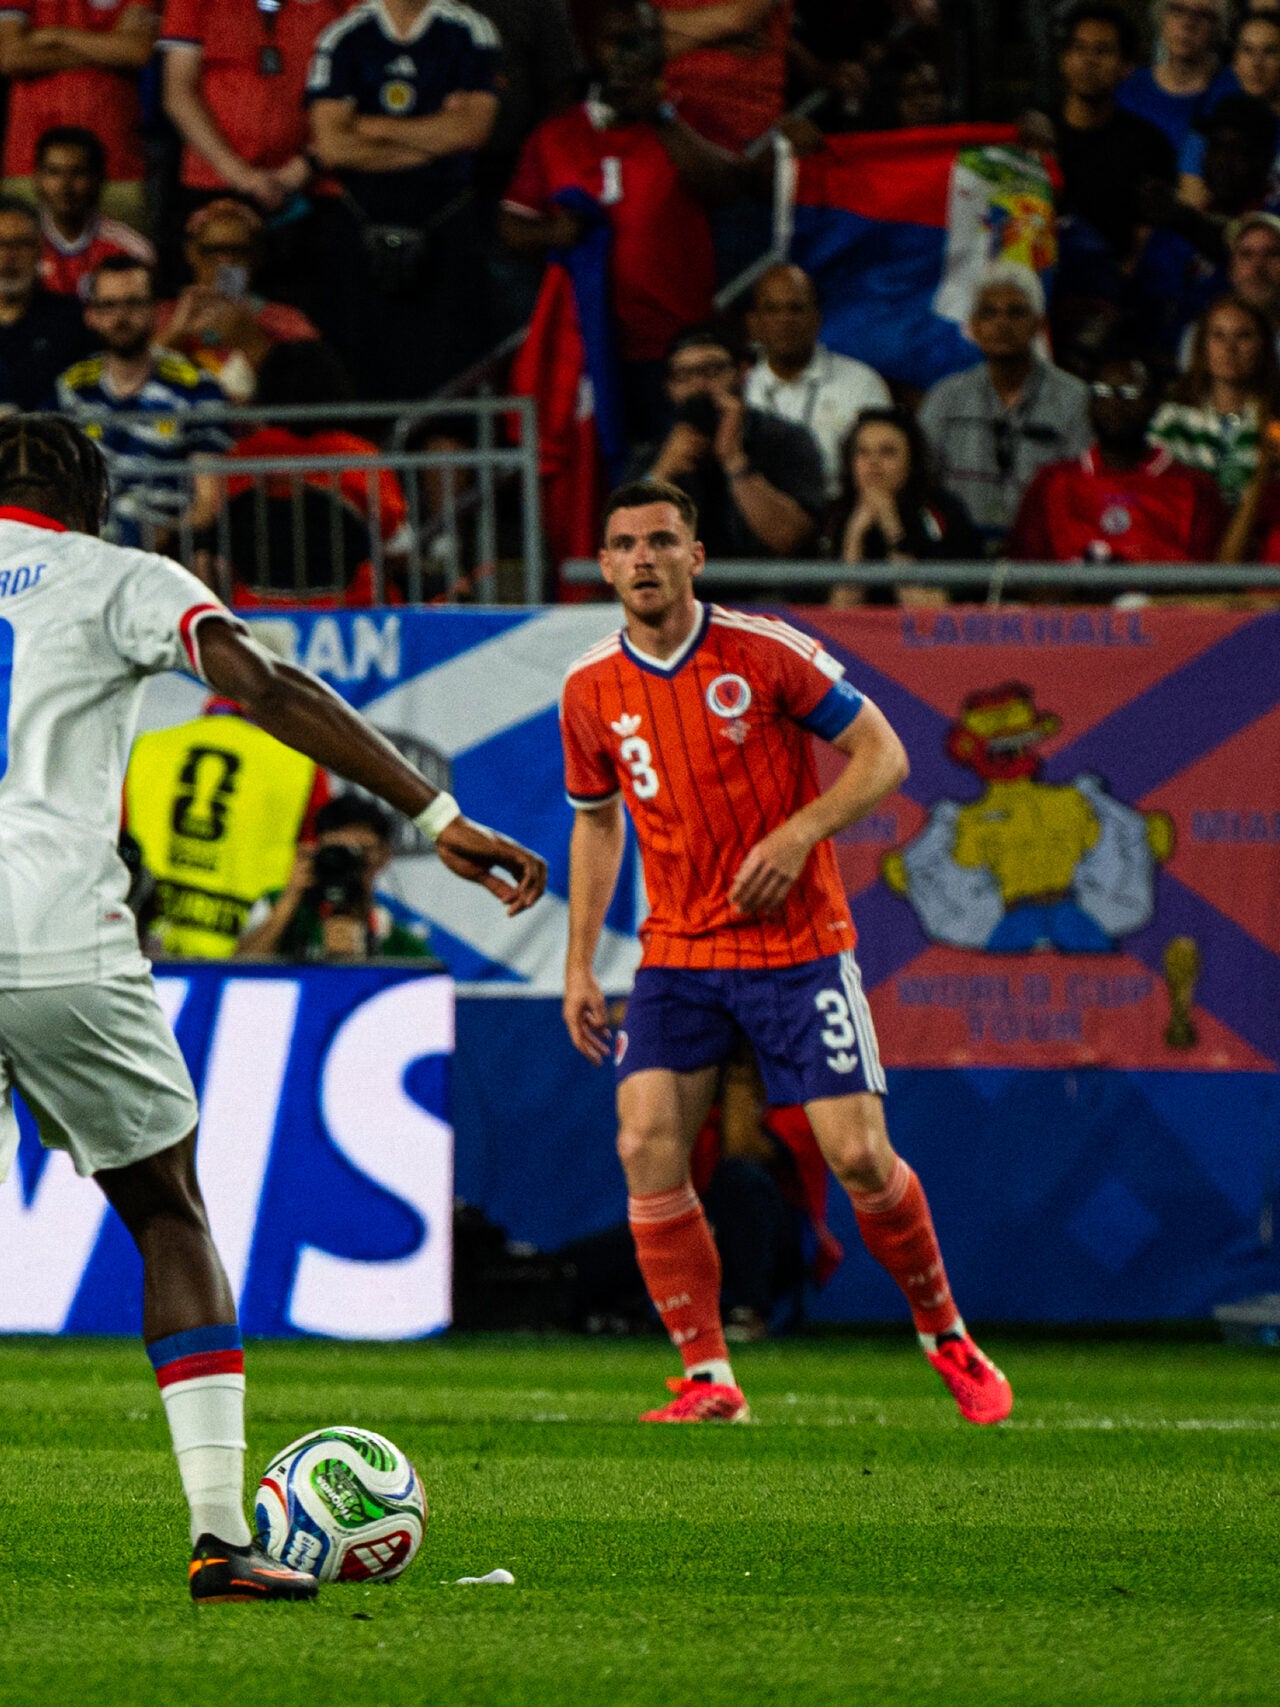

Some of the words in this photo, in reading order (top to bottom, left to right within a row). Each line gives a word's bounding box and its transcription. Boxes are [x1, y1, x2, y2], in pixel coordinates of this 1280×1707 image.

[901, 610, 1152, 648] LARKHALL
[621, 736, 659, 799] 3
[814, 987, 856, 1051] 3
